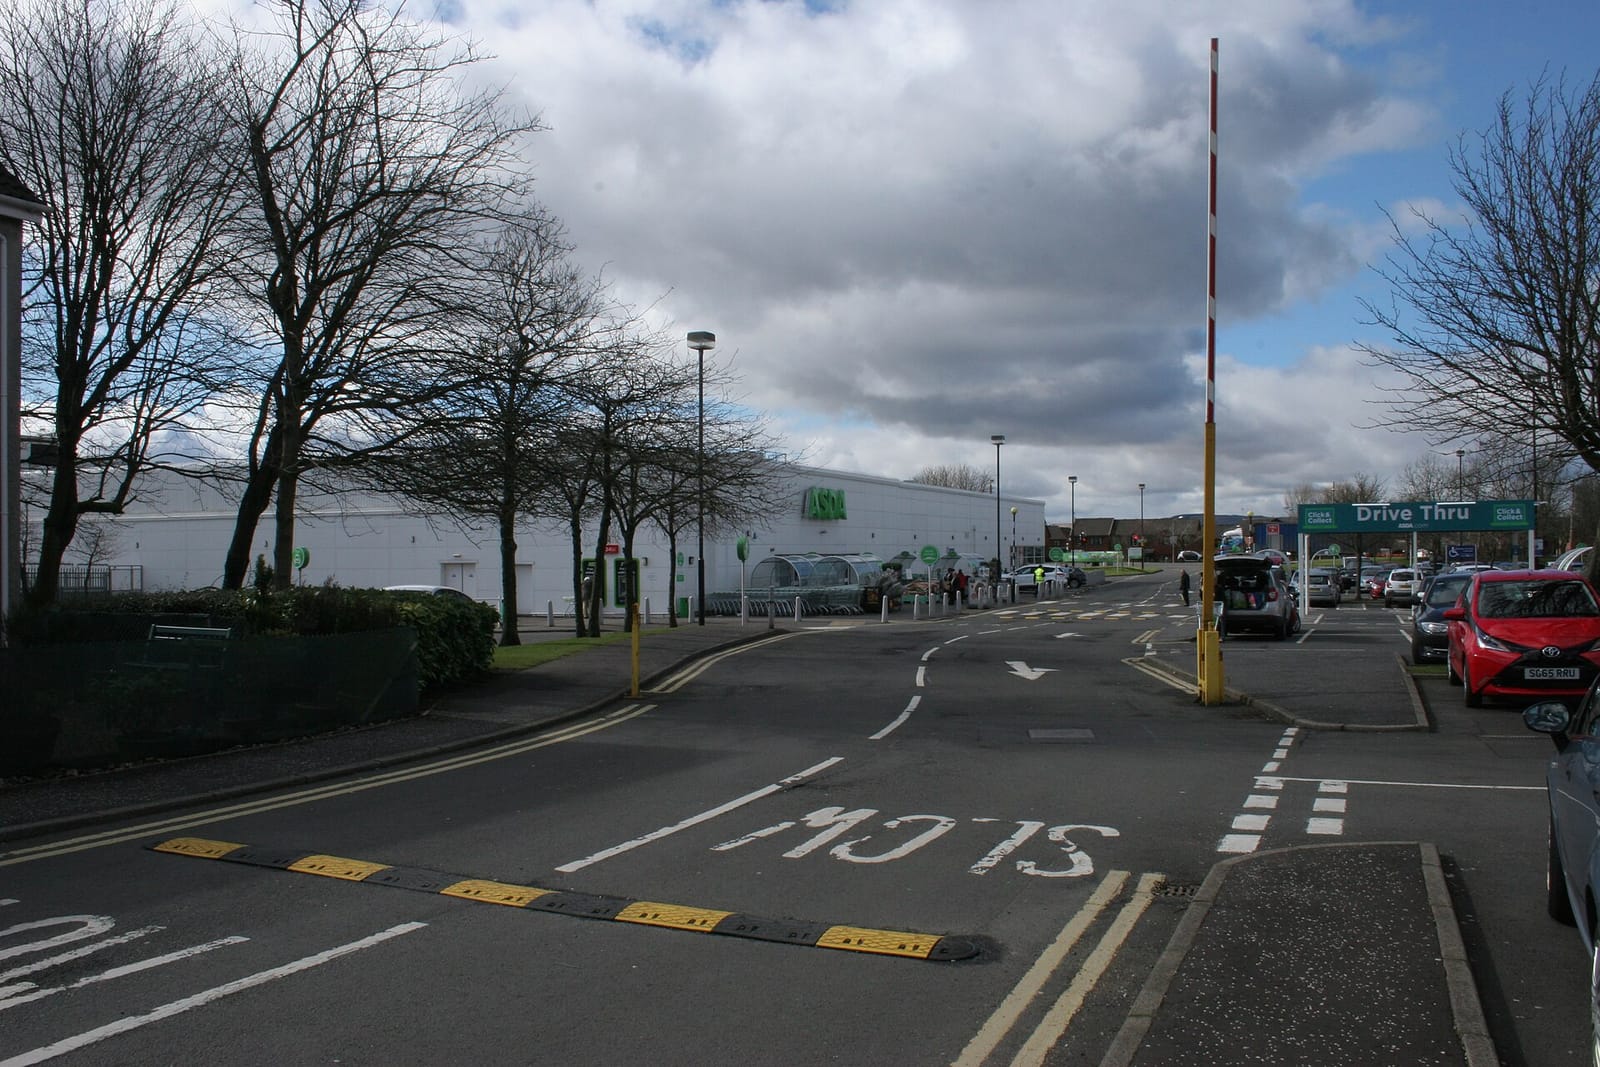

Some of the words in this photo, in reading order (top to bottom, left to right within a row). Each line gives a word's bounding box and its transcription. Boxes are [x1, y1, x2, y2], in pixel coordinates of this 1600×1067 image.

[806, 486, 847, 520] ASDA
[1357, 506, 1413, 521] Drive
[1419, 504, 1469, 520] Thru
[1528, 669, 1554, 678] SG65
[1556, 669, 1575, 678] RRU
[709, 806, 1120, 877] SLOW
